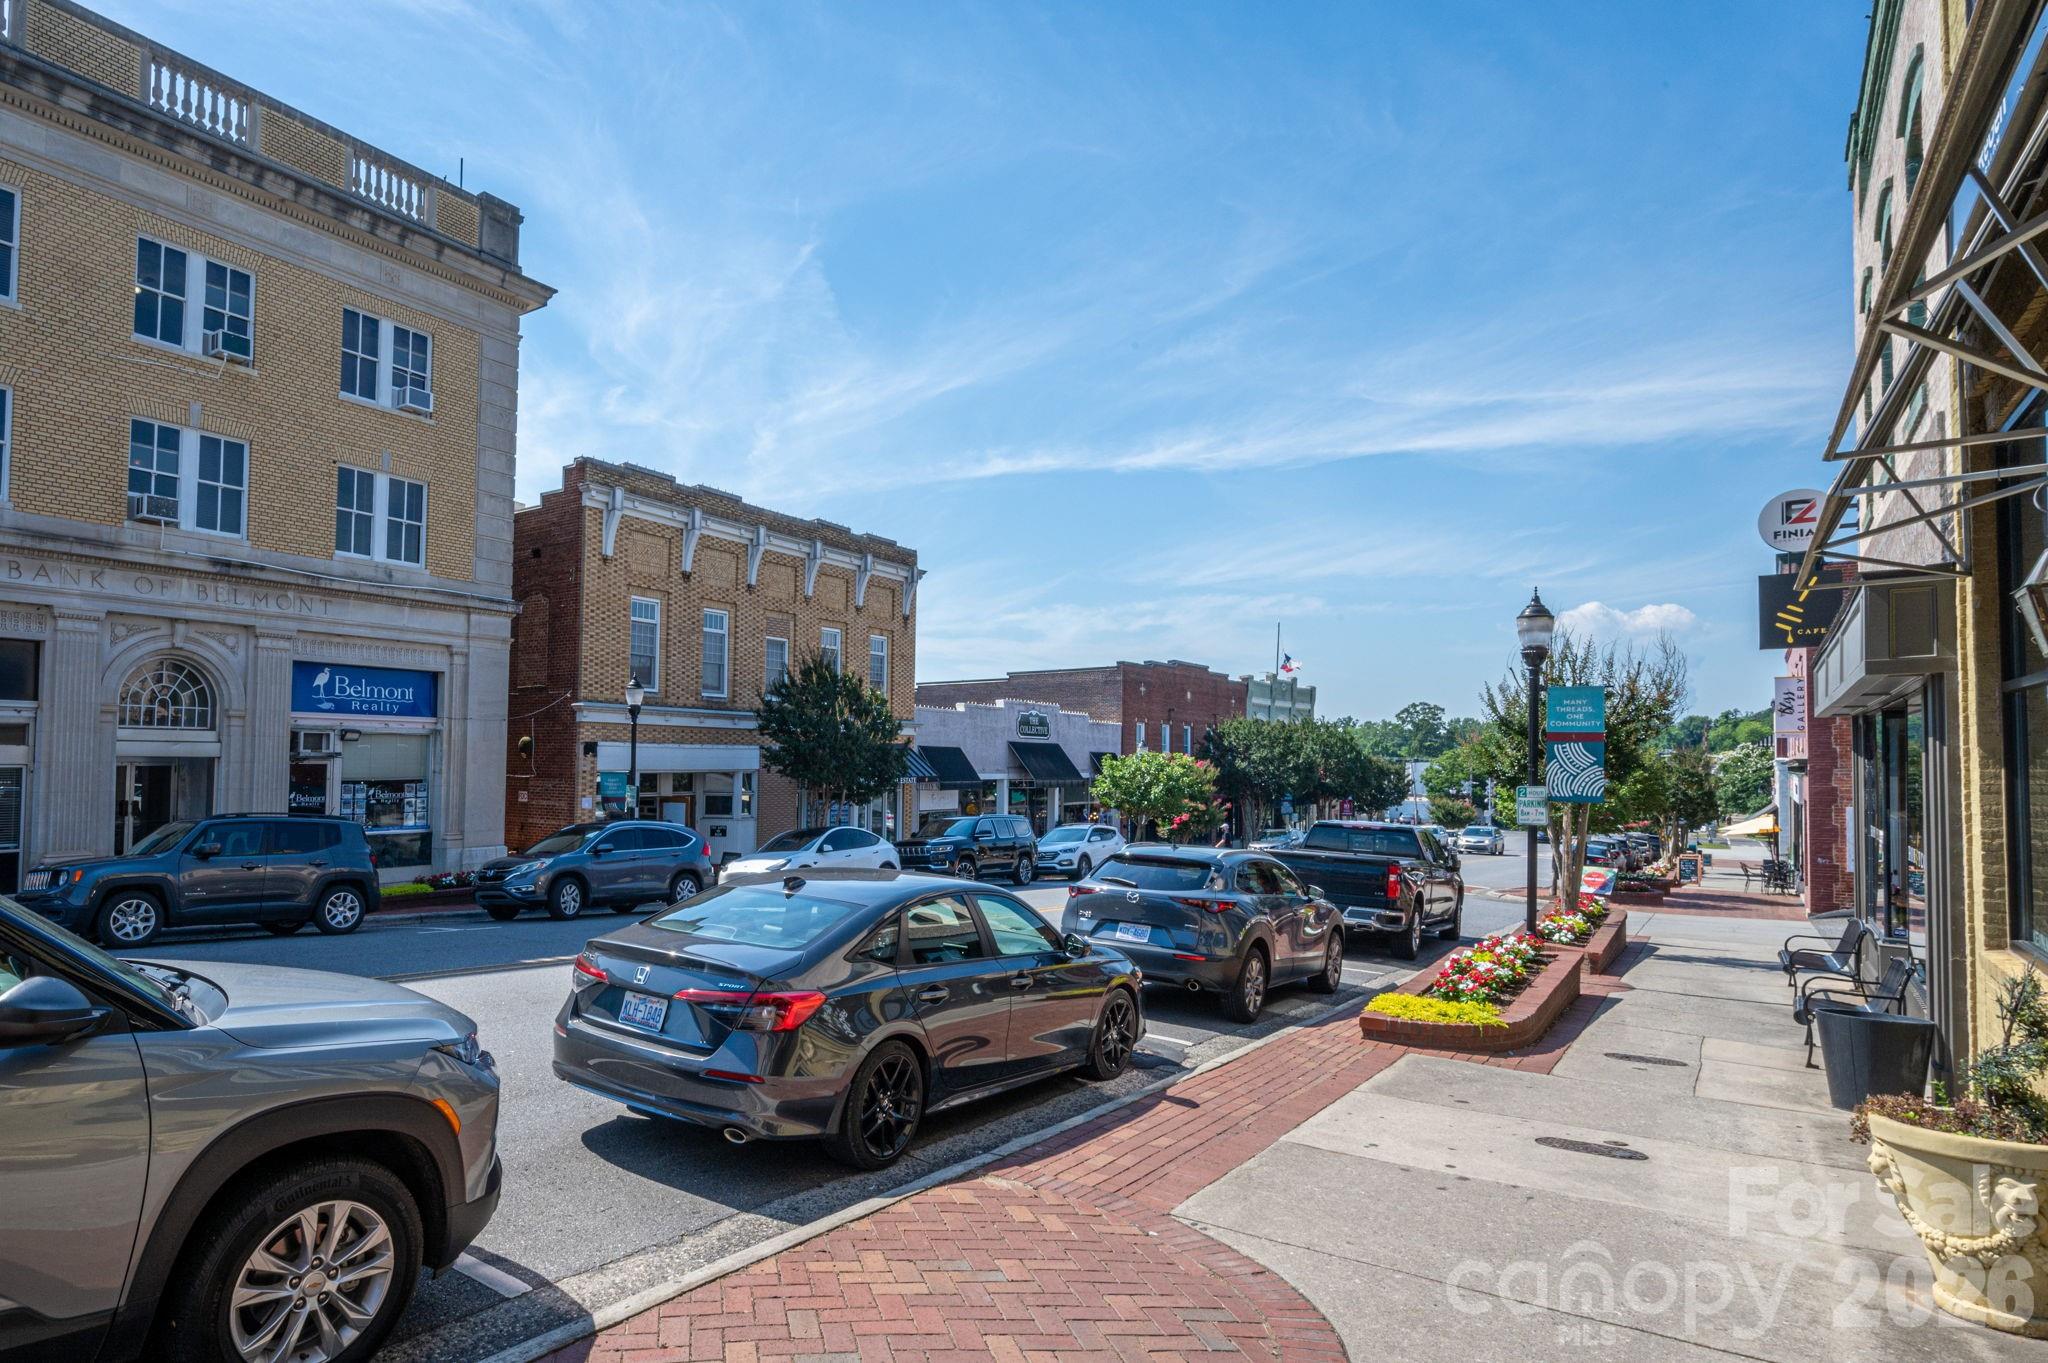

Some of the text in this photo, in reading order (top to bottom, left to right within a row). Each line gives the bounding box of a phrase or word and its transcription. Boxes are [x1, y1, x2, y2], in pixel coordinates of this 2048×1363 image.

[7, 559, 333, 615] BANK OF BELMONT
[334, 675, 414, 700] Belmont
[351, 700, 400, 713] Realty
[1796, 678, 1805, 731] GALLERY
[1029, 716, 1040, 725] THE
[1020, 725, 1049, 735] COLLECTIVE
[375, 789, 406, 799] Belmont
[1519, 788, 1526, 797] 2
[296, 793, 326, 803] Belmont
[1519, 800, 1546, 808] PARKING
